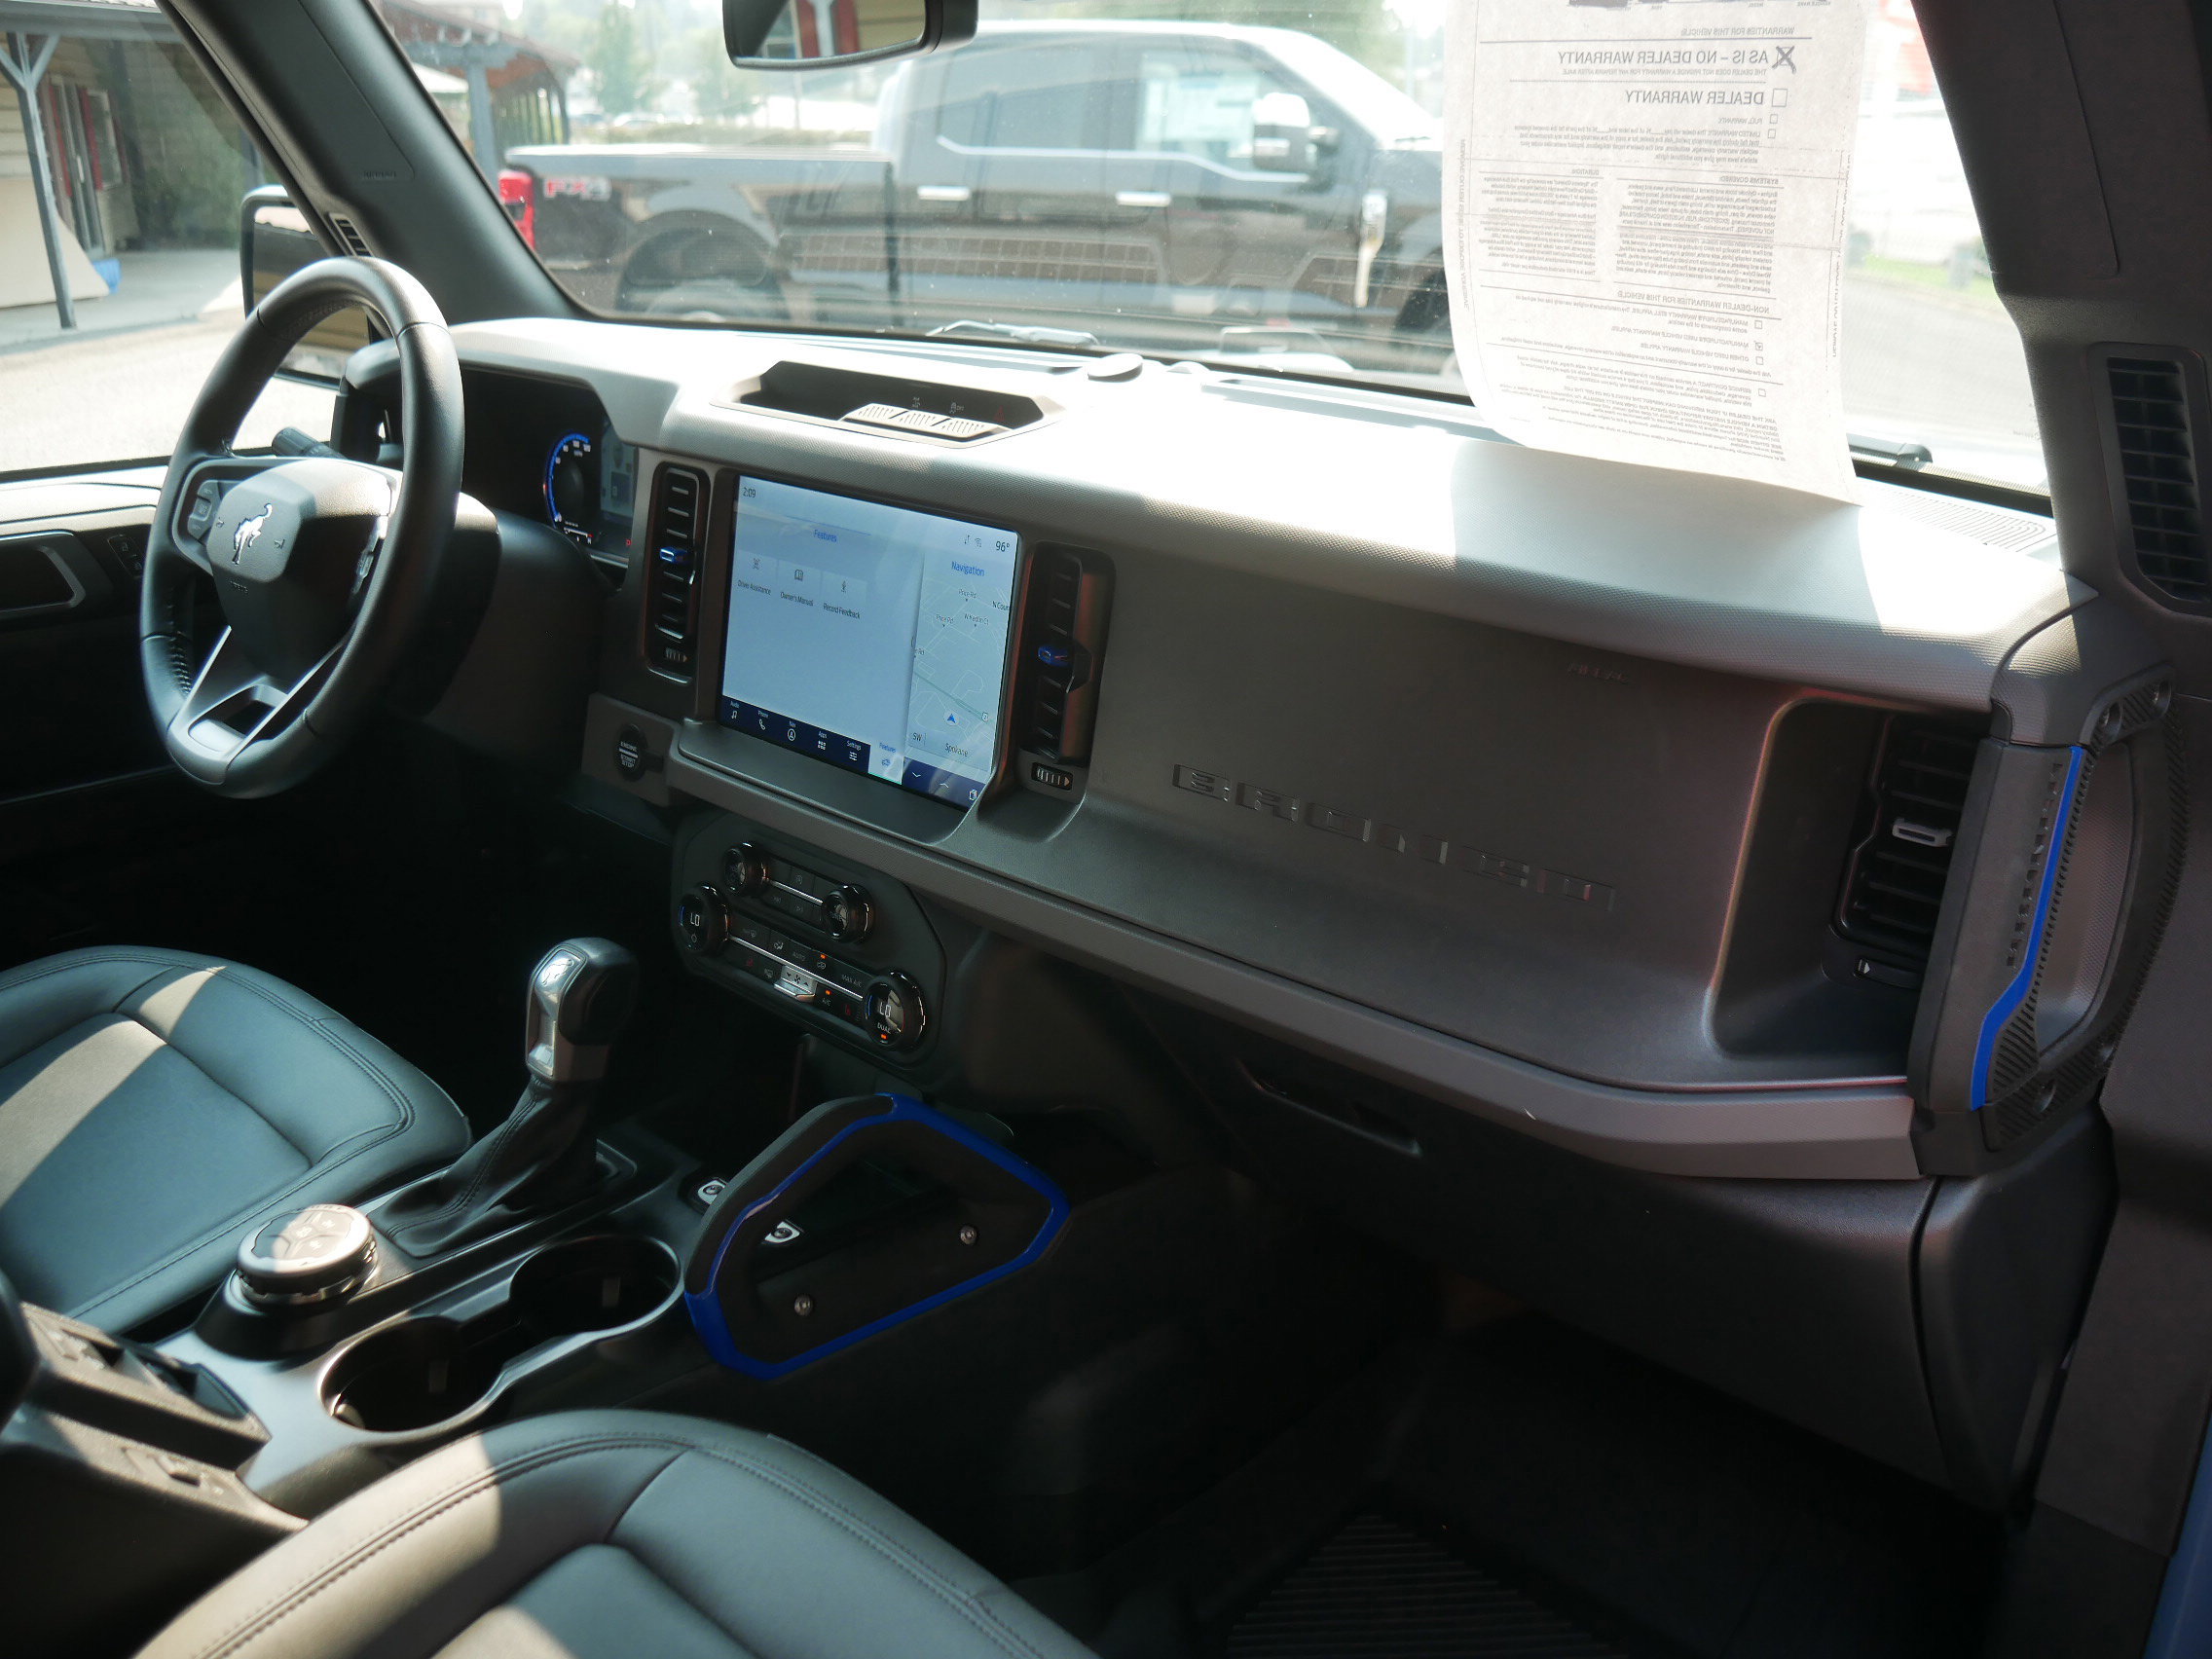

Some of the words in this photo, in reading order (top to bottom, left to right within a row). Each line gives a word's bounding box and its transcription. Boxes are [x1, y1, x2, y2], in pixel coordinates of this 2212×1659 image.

[743, 487, 756, 498] 2:09
[814, 530, 837, 543] Features
[995, 540, 1011, 552] 96°
[951, 561, 985, 577] Navigation
[823, 603, 838, 613] Record
[944, 743, 969, 757] Spokane
[690, 912, 700, 927] LO
[880, 1002, 891, 1018] LO
